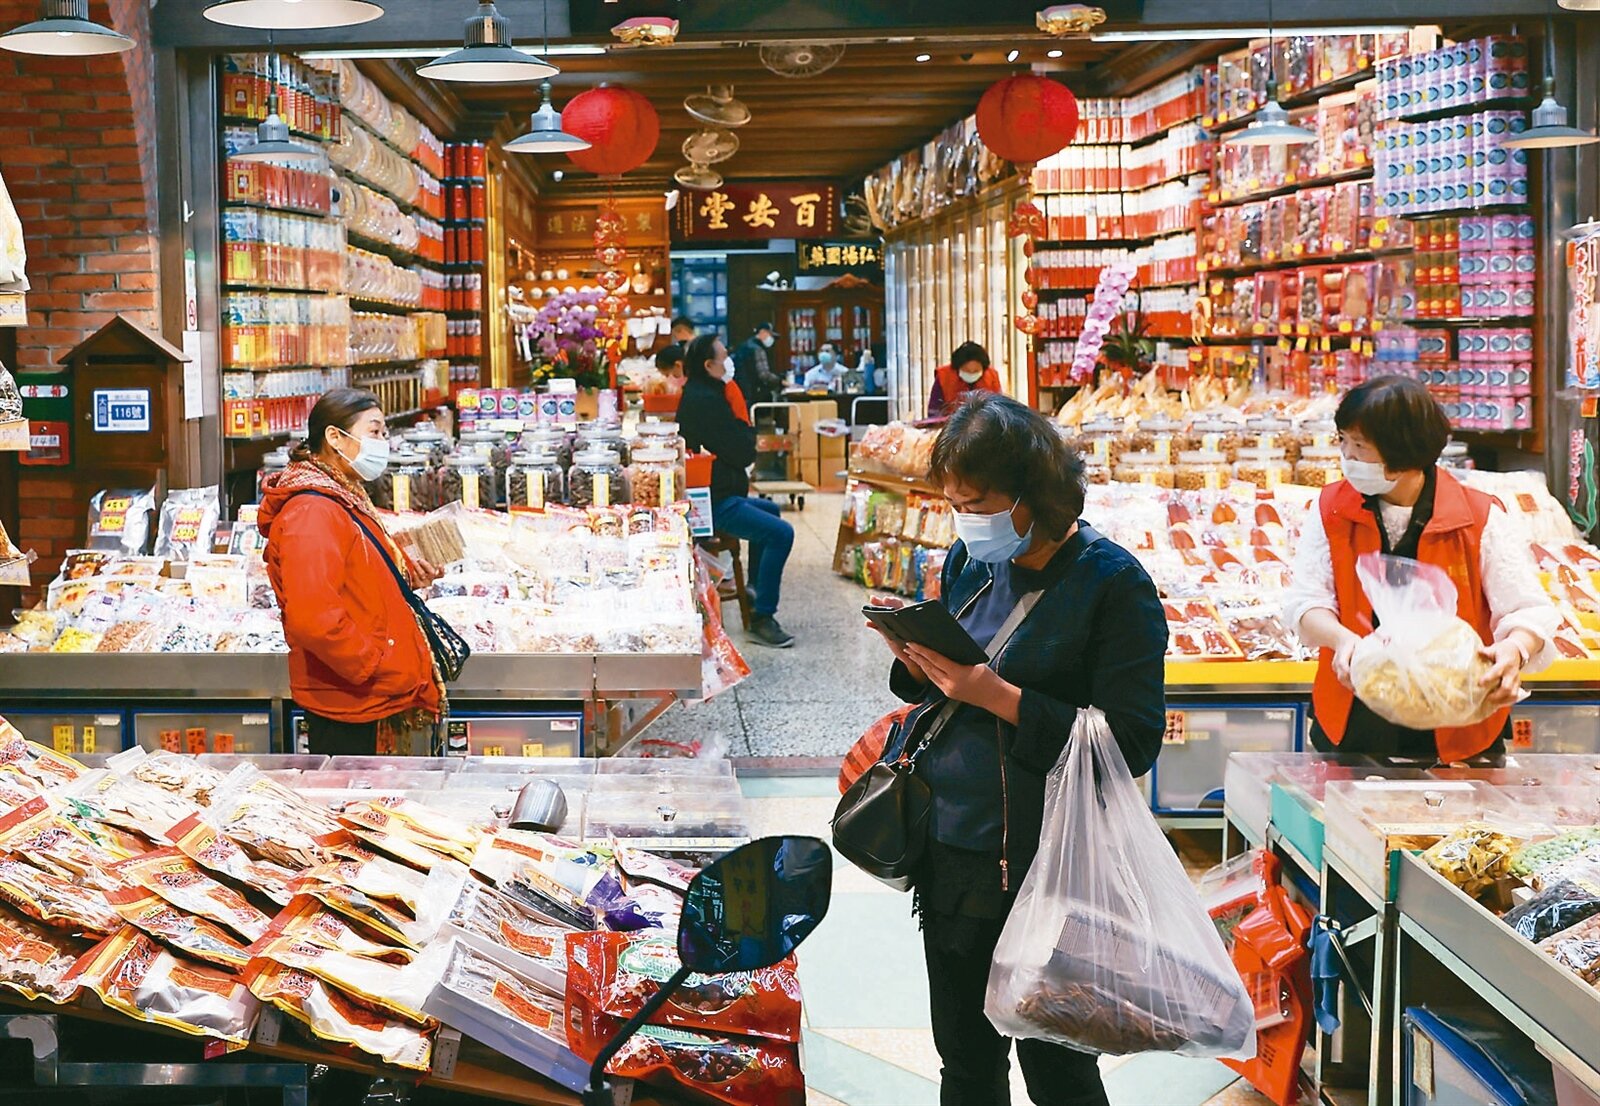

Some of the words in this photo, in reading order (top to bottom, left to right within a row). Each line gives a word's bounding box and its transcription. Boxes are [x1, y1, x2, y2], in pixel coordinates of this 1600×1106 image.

[700, 191, 821, 230] 百安堂
[115, 406, 142, 419] 116號
